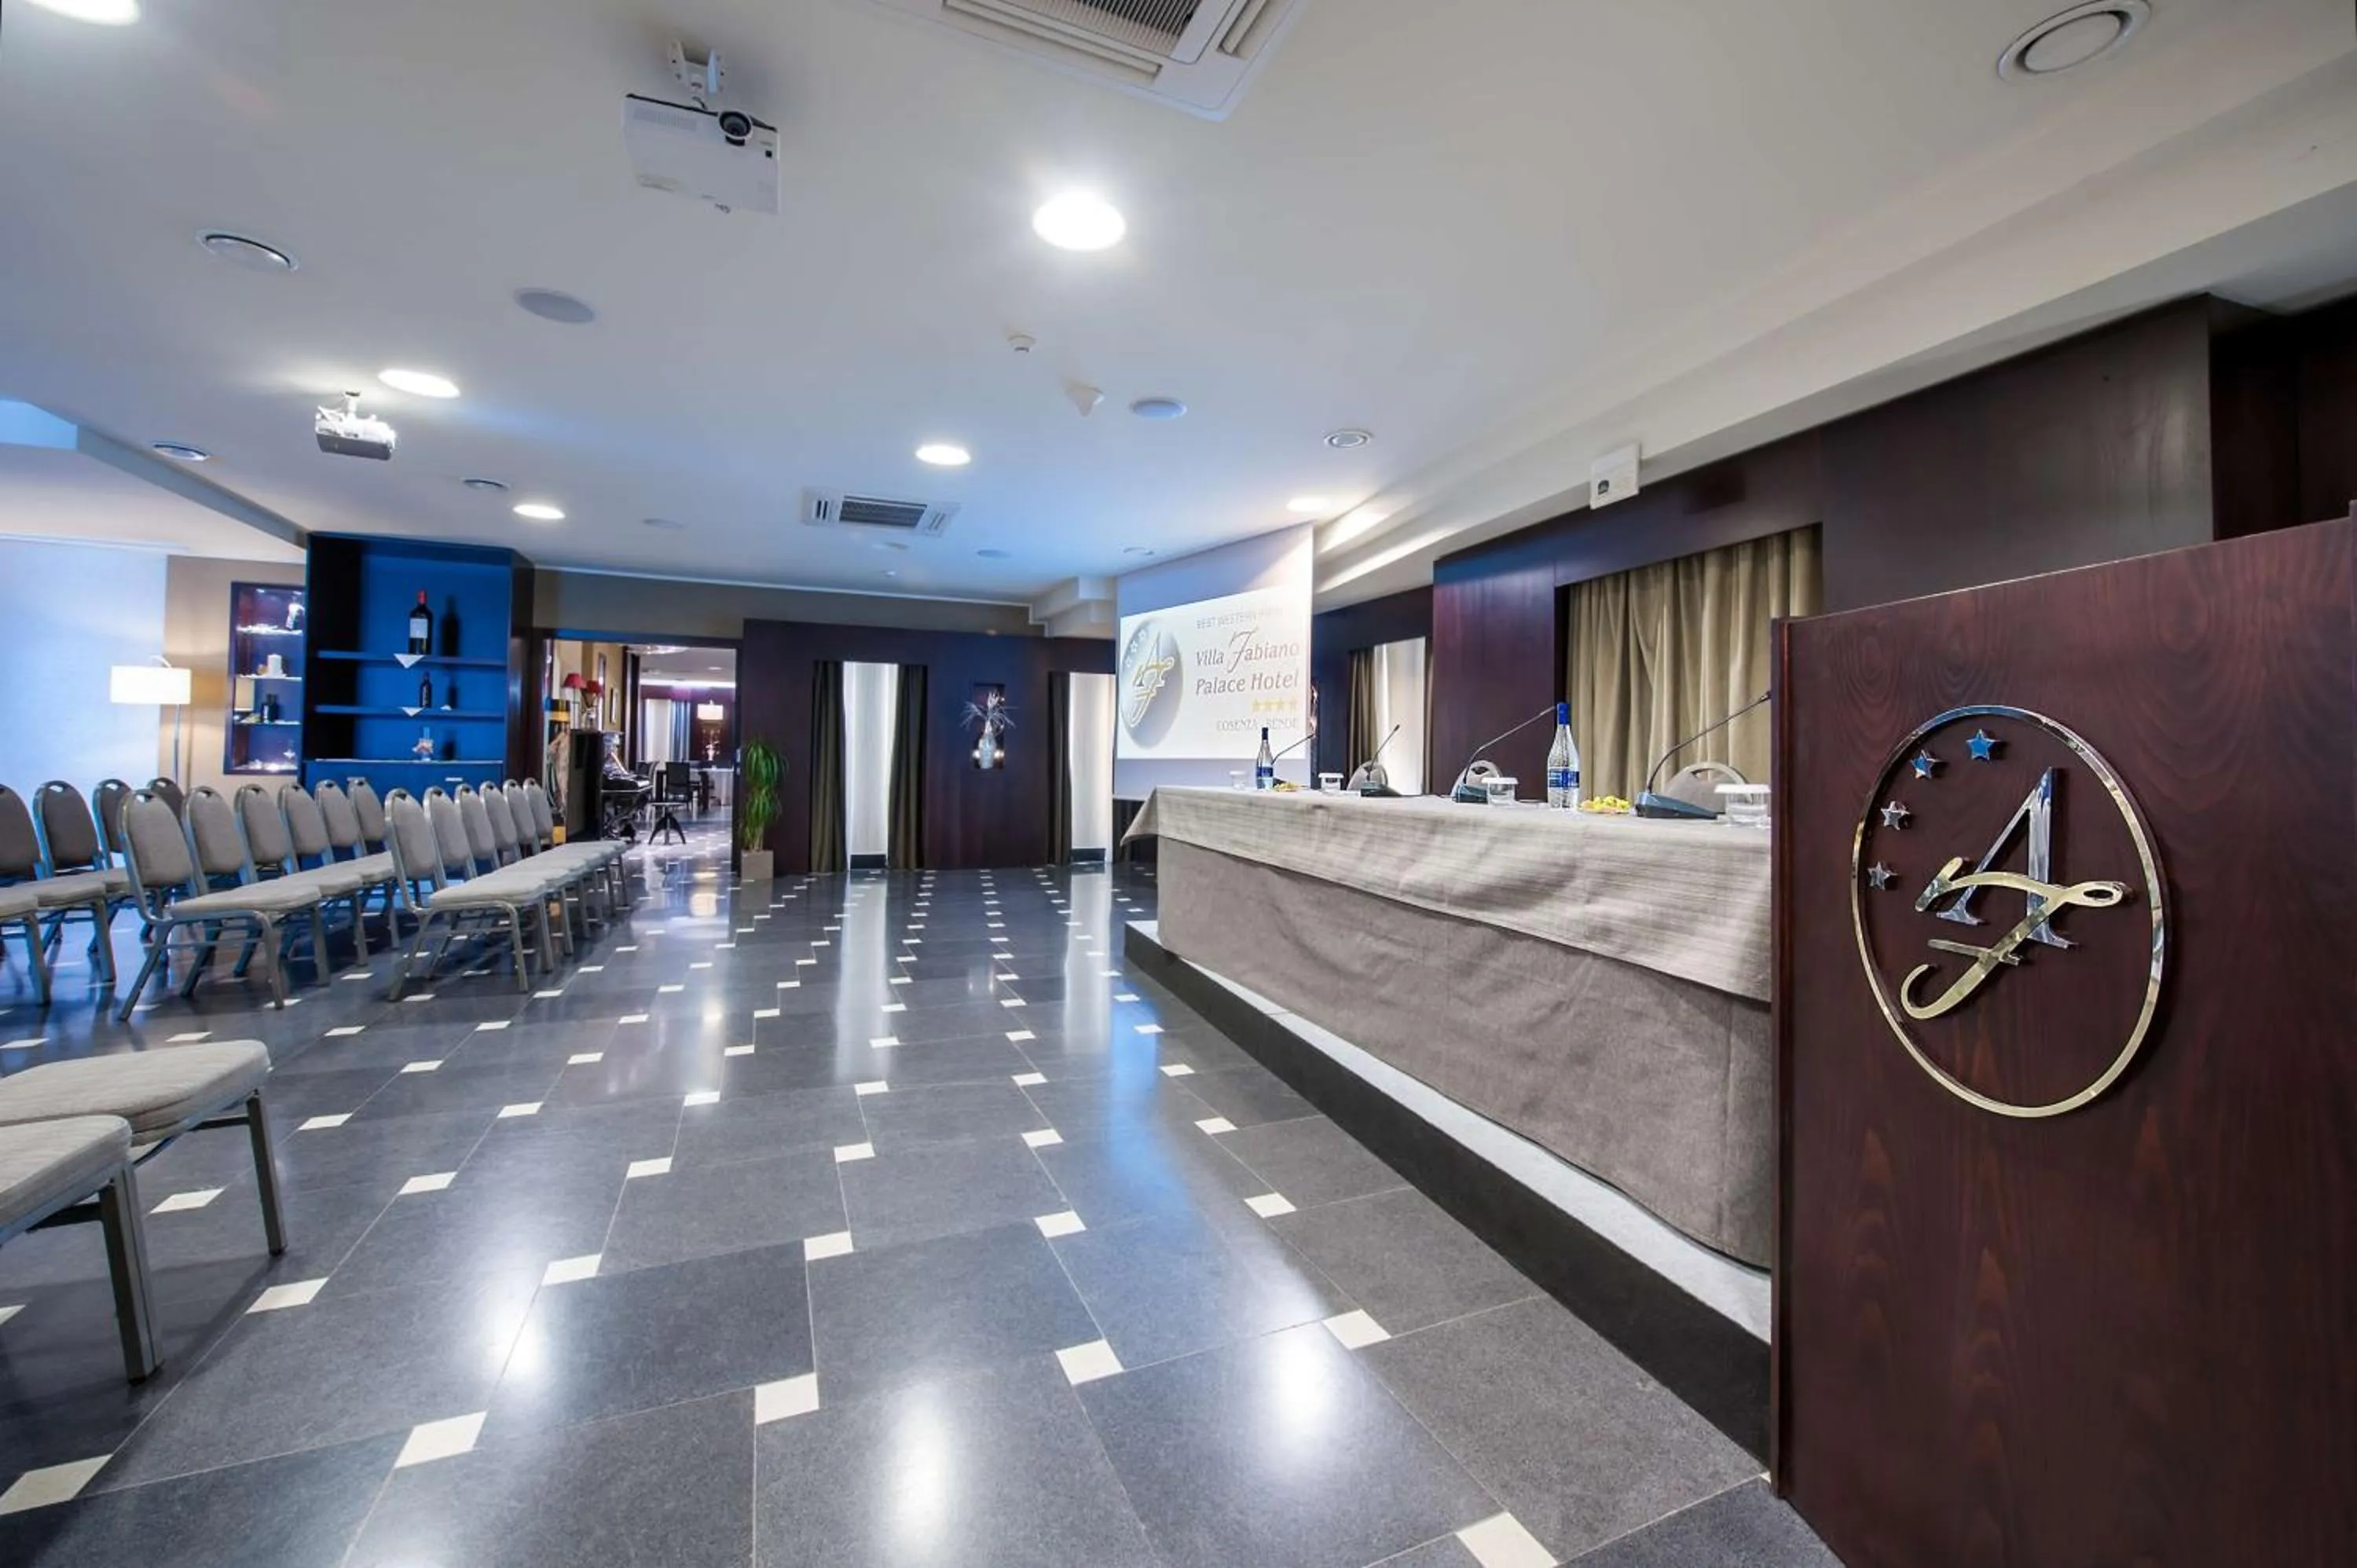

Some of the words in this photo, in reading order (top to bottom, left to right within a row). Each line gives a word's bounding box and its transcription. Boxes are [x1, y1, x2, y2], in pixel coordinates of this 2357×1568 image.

[1196, 649, 1224, 666] Villa
[1227, 627, 1300, 673] Fabiano
[1195, 677, 1246, 696] Palace
[1251, 669, 1299, 691] Hotel
